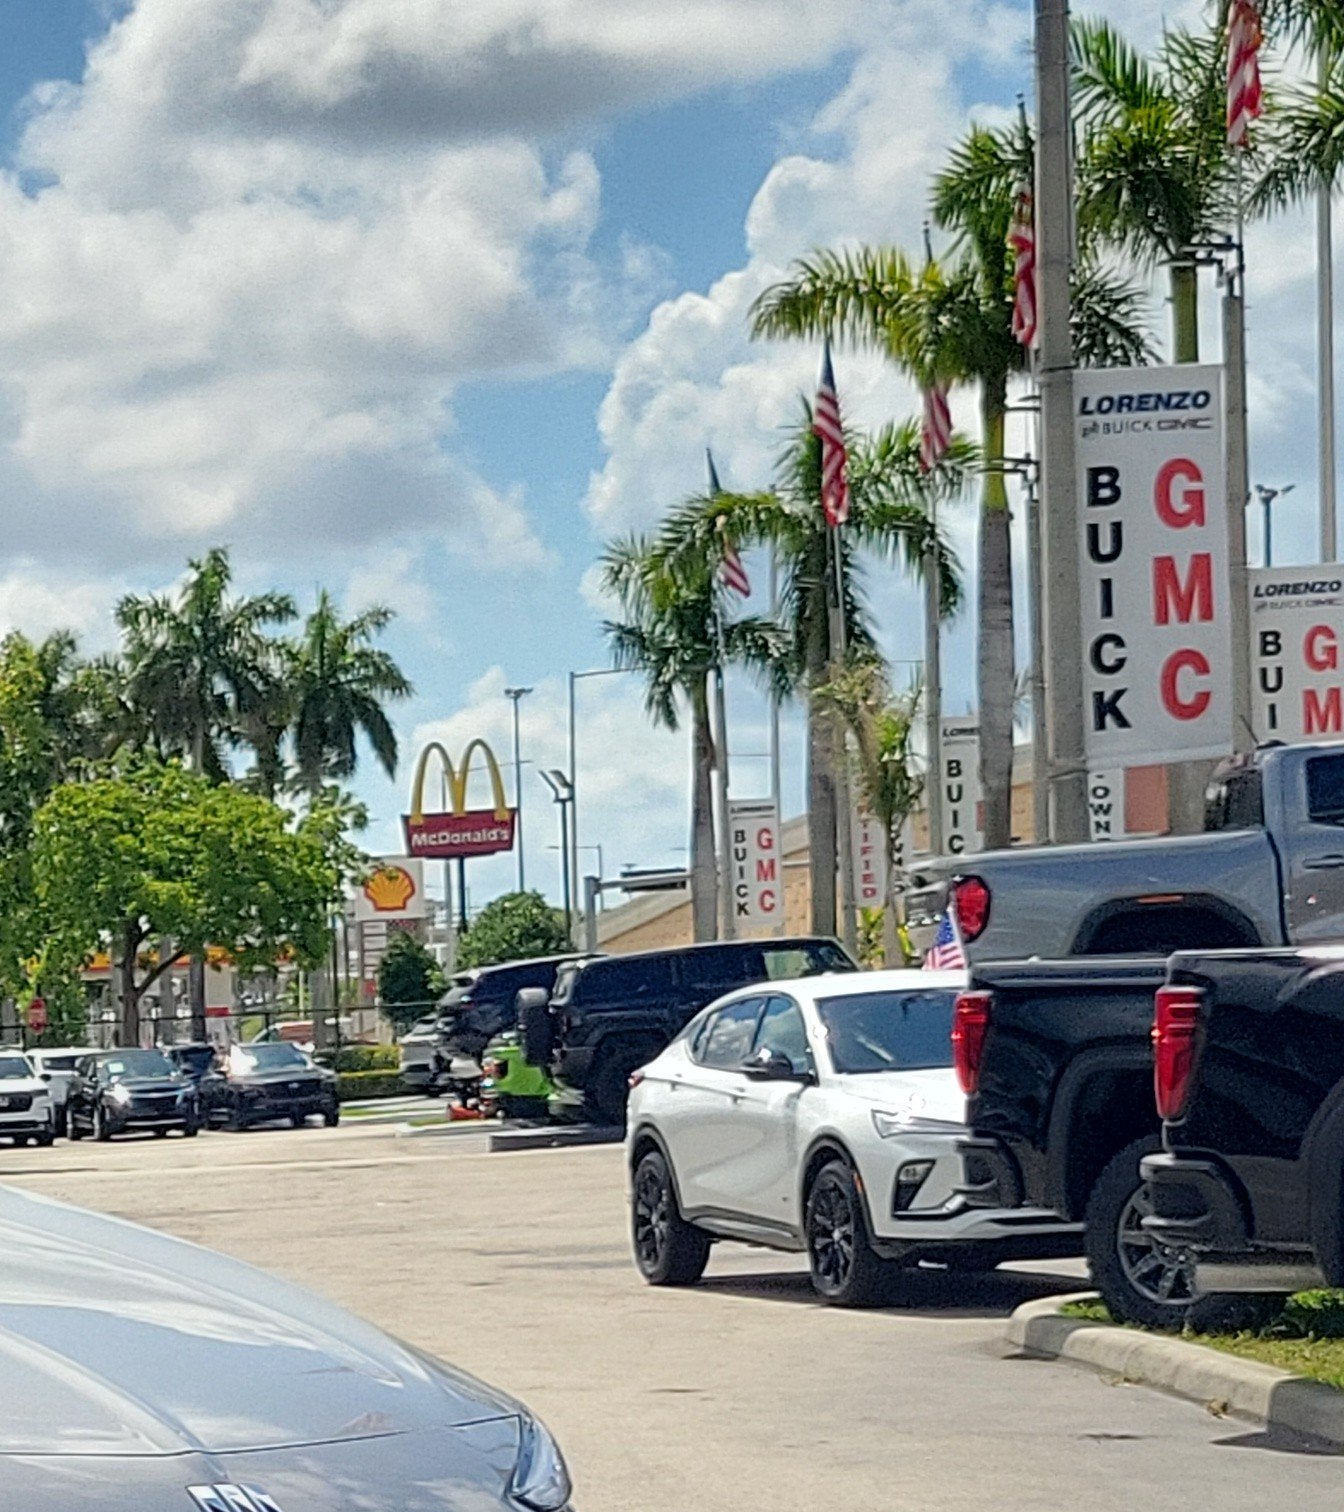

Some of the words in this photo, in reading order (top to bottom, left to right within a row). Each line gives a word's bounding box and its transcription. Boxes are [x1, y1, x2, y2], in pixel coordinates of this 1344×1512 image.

[1080, 389, 1211, 415] LORENZO
[1102, 420, 1152, 434] BUICK
[1157, 417, 1212, 431] GMC
[1087, 466, 1131, 731] BUICK
[1152, 457, 1212, 721] GMC
[1254, 580, 1342, 598] LORENZO
[1259, 630, 1283, 730] BUI
[1302, 624, 1342, 735] GM
[412, 829, 509, 847] McDonald's
[946, 759, 964, 854] BUIC
[734, 829, 750, 917] BUICK
[756, 827, 776, 913] GMC
